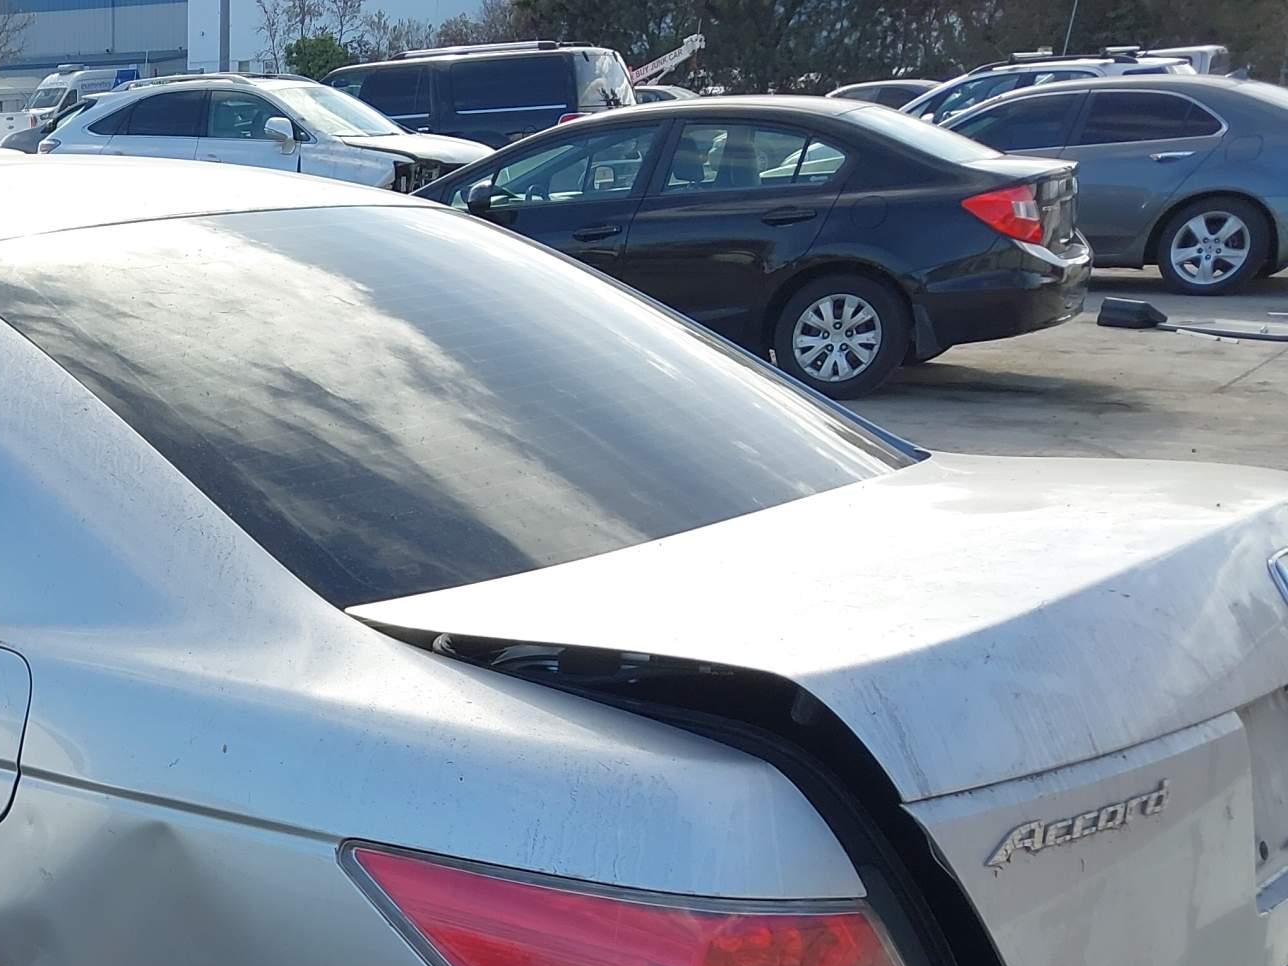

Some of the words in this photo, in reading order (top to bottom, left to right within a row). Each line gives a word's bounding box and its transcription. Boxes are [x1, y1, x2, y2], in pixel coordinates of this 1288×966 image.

[636, 66, 649, 77] BUY
[651, 57, 668, 70] JUNK
[985, 777, 1169, 867] Accord
